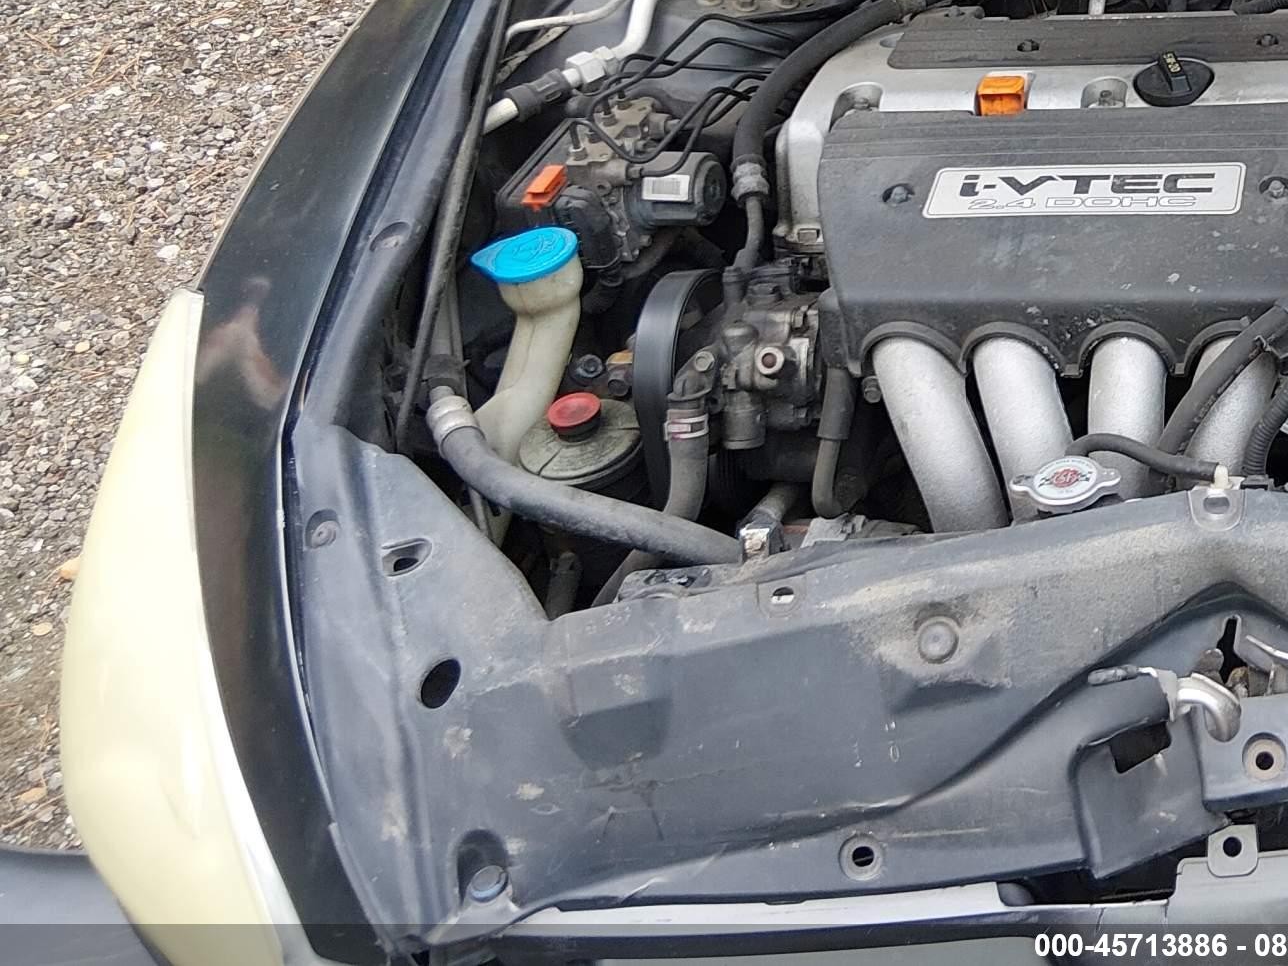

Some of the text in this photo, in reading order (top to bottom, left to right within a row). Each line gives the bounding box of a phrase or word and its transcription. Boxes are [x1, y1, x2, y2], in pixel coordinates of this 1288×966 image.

[960, 173, 1215, 197] i-VTEC
[968, 196, 1196, 210] 2.4 DOHC
